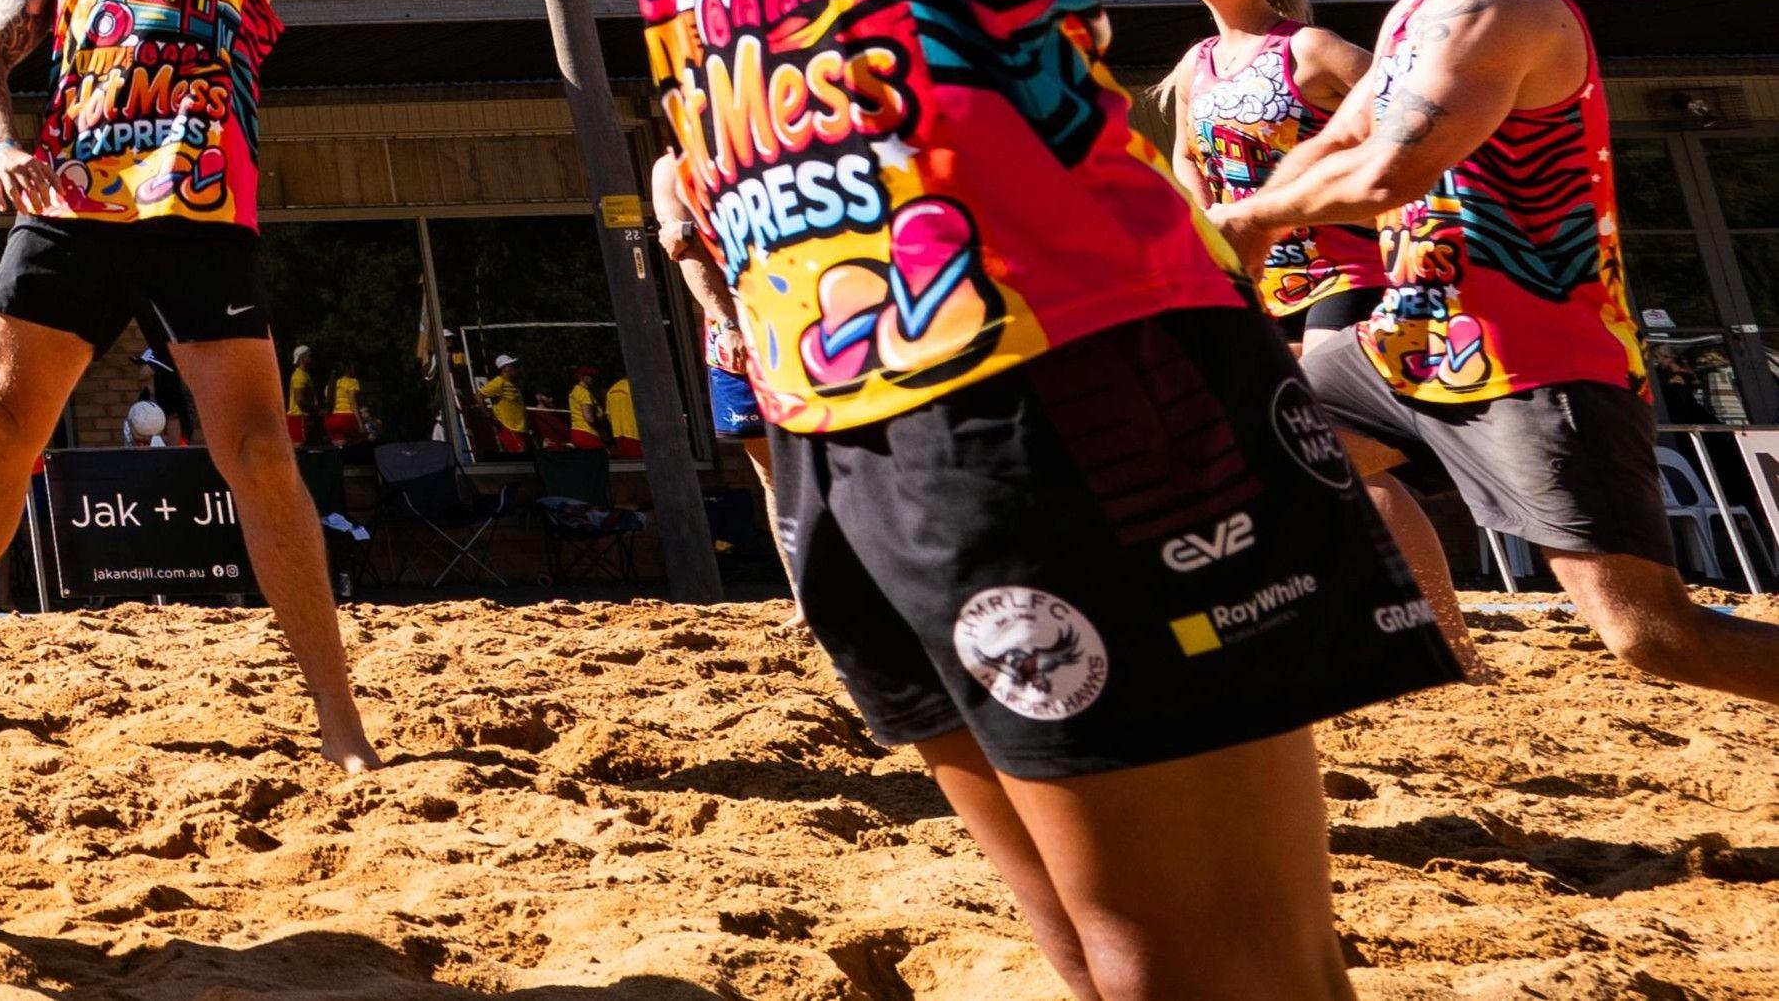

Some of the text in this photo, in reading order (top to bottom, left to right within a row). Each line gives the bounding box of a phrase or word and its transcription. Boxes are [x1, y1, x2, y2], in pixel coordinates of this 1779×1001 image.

[62, 64, 228, 141] Hot Mess
[705, 34, 907, 185] Mess
[76, 116, 206, 161] EXPRESS
[624, 230, 641, 241] 22
[710, 154, 883, 286] XPRESS
[71, 493, 141, 528] Jak
[193, 490, 236, 526] Jil
[1162, 512, 1256, 573] EV2
[92, 567, 206, 582] jakandjill.com.au
